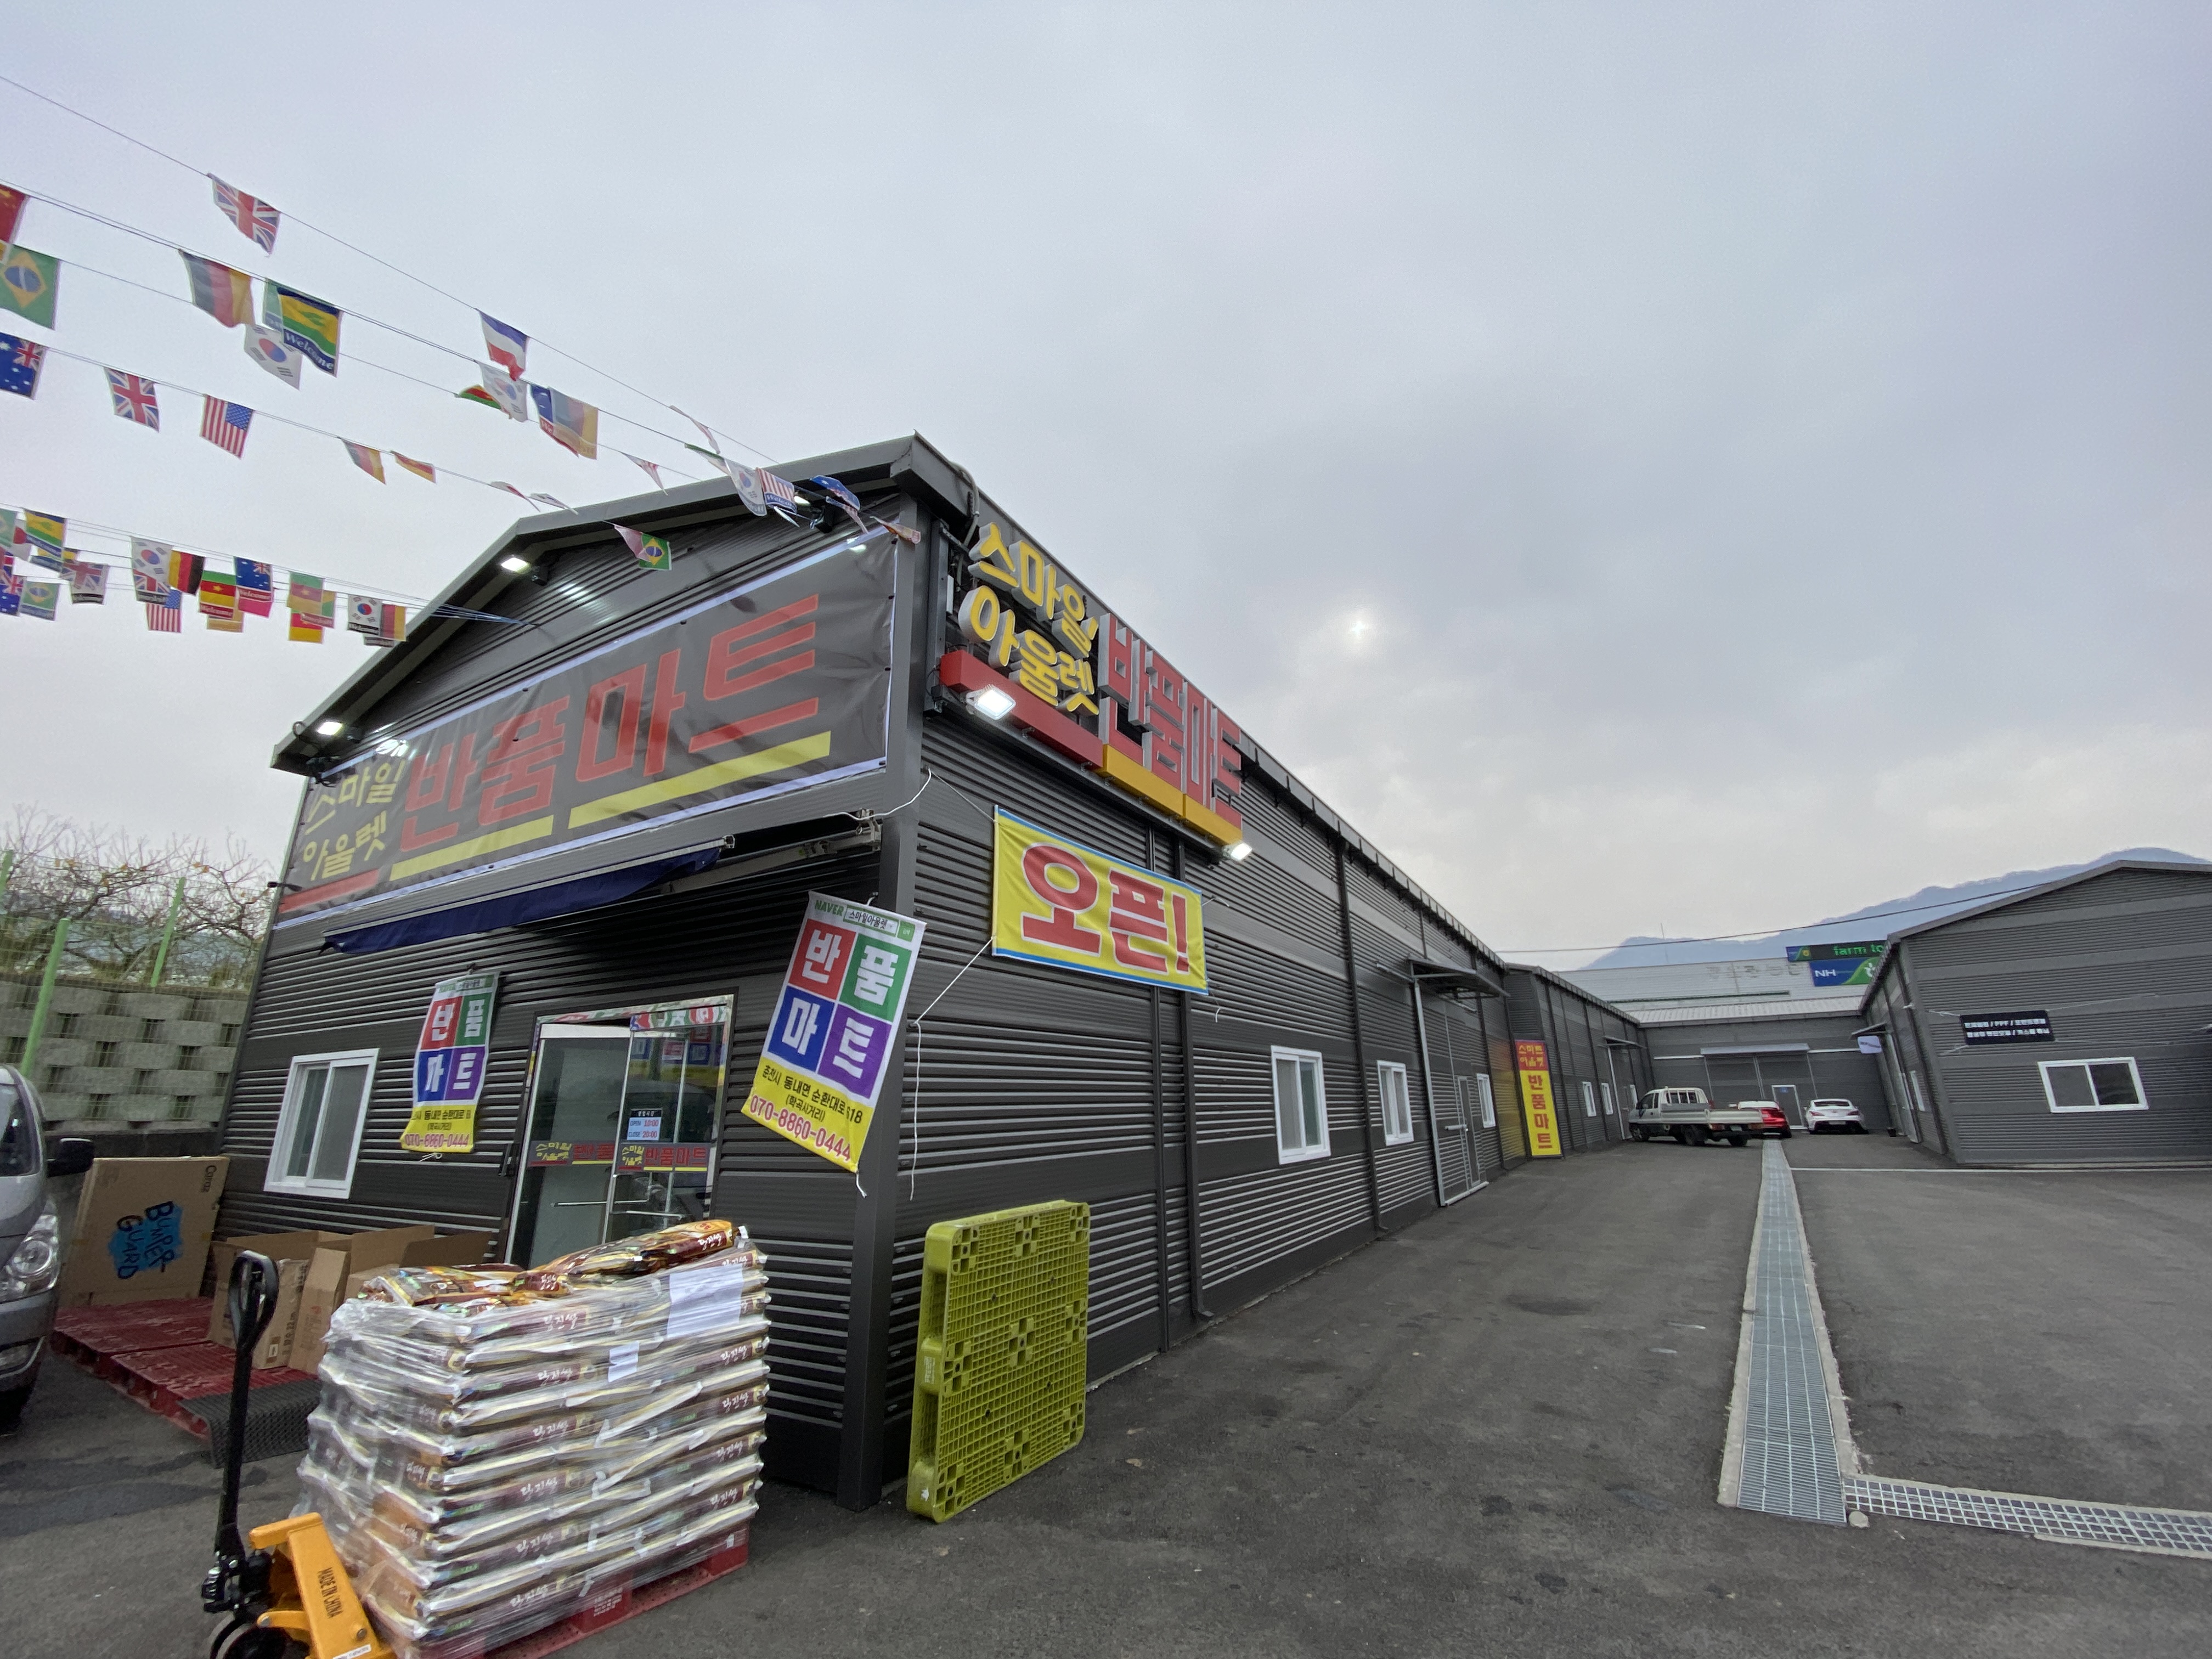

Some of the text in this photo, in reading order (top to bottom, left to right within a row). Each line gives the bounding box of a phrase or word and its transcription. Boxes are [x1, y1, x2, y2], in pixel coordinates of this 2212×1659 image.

[285, 331, 334, 369] Welcome
[968, 522, 1099, 658] 스마일
[958, 585, 1099, 715] 아울렛
[401, 593, 820, 852] 반품마트
[1097, 613, 1243, 830] 반품마트
[305, 760, 406, 835] 스마일
[303, 810, 387, 881] 아울렛
[815, 900, 845, 916] NAVER
[1021, 842, 1190, 975] 오픈!
[1833, 946, 1867, 956] farm
[762, 1065, 782, 1086] 춘천시
[784, 1076, 811, 1098] 동내면
[812, 1089, 847, 1115] 순환대로
[1528, 1075, 1552, 1149] 반품마트
[644, 1146, 707, 1166] 반품마트
[750, 1095, 851, 1161] 070-8860-0444
[117, 1215, 143, 1279] GUARD
[317, 1567, 344, 1618] MADE IN CHINA
